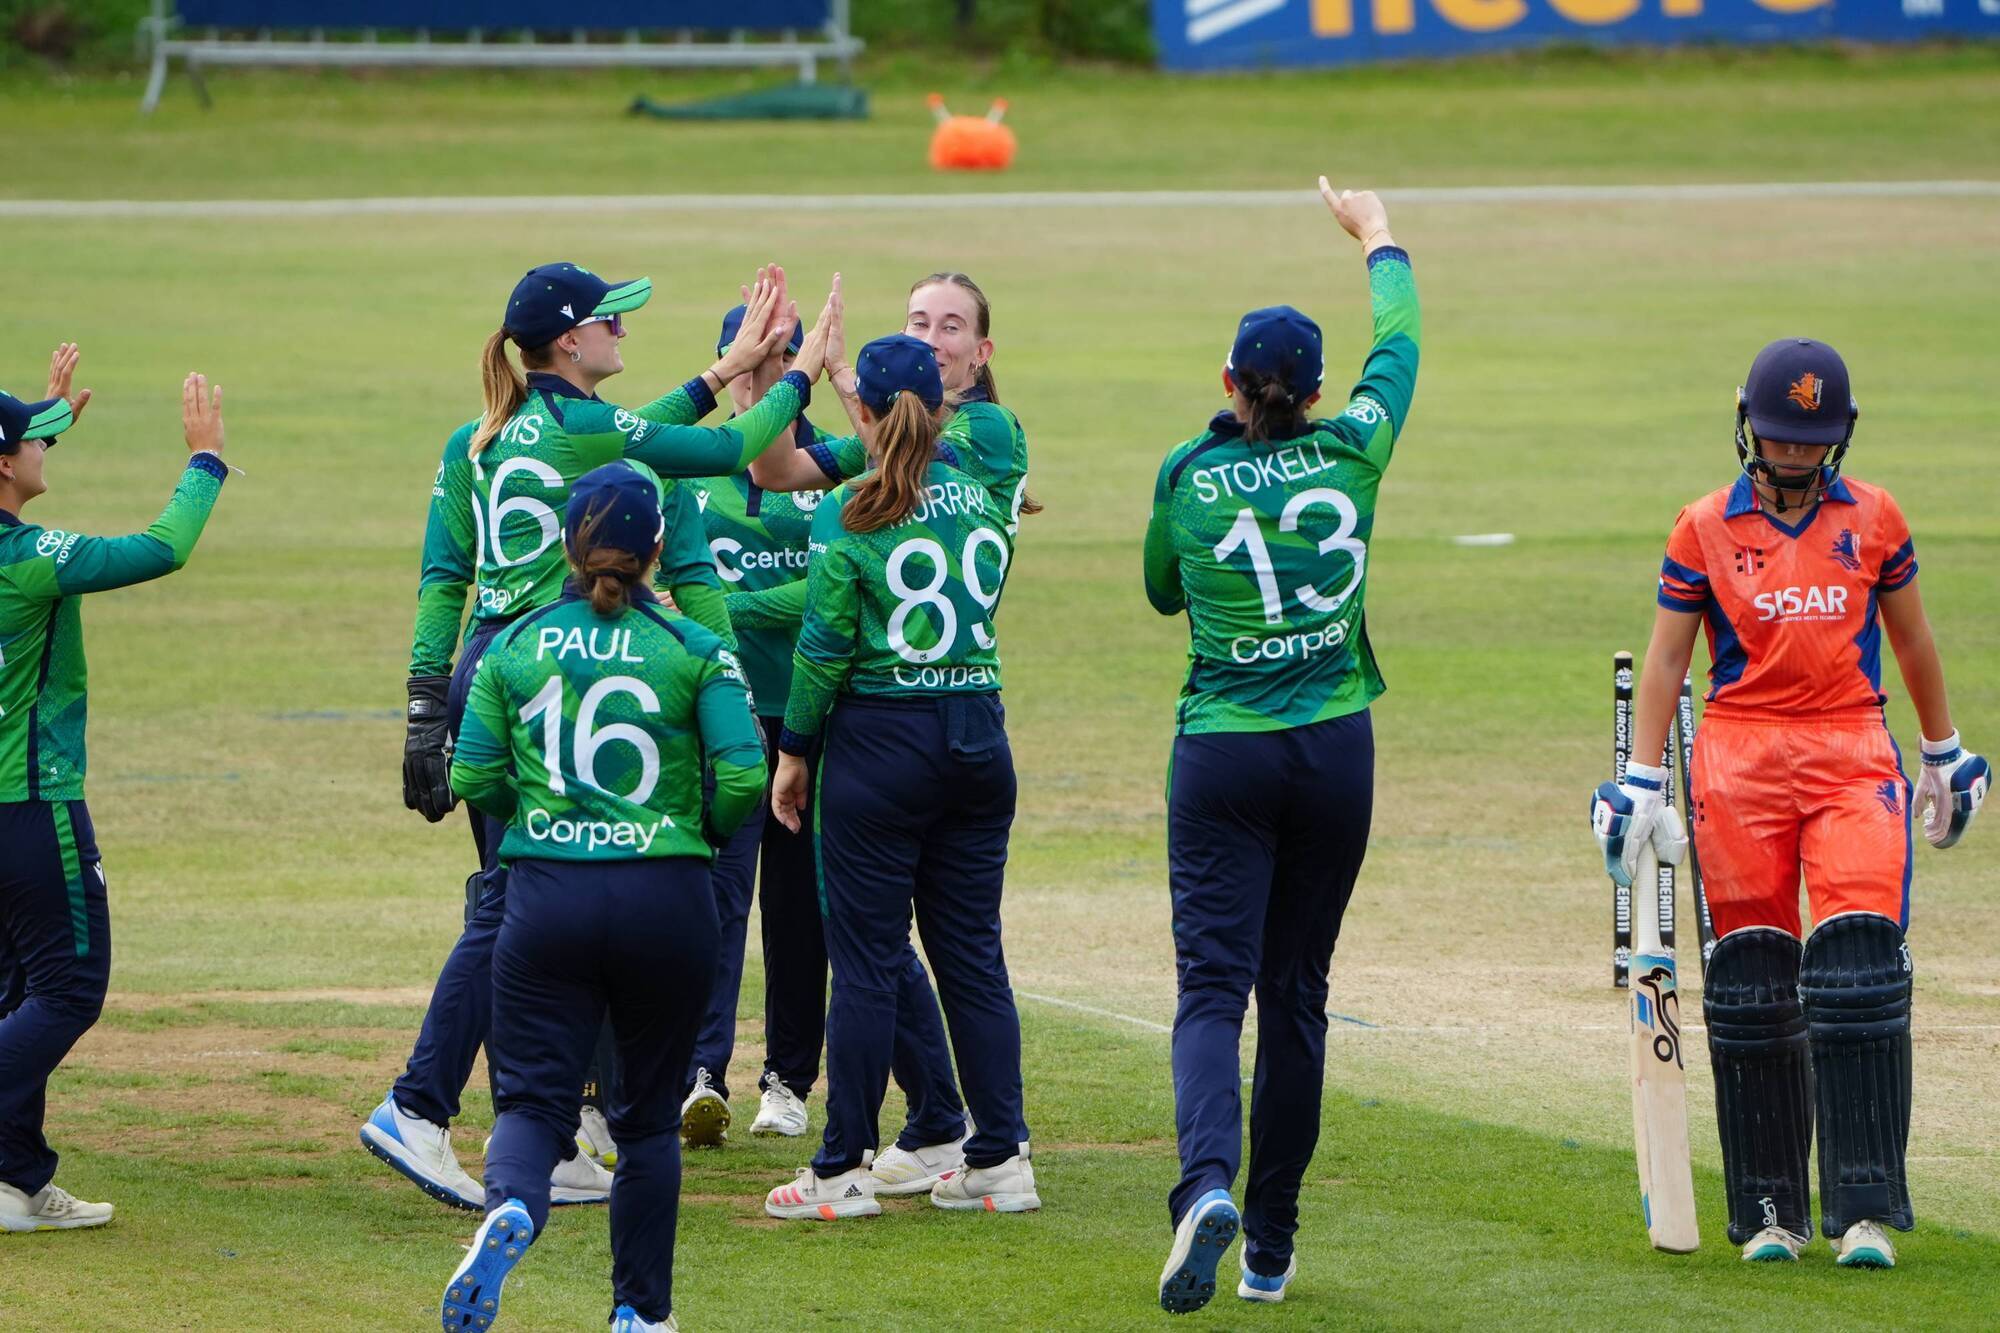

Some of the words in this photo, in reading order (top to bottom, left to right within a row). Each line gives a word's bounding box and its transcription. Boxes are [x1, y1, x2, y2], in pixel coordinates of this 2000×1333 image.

[1192, 441, 1337, 503] STOKELL
[892, 481, 988, 528] URRAY
[1213, 487, 1366, 624] 13
[886, 527, 1008, 663] 89
[1753, 585, 1848, 621] SISAR
[535, 627, 645, 663] PAUL
[518, 674, 662, 806] 16
[1615, 699, 1627, 749] EUROPE
[1679, 696, 1693, 745] EUROPE
[1616, 886, 1630, 932] EAM11
[1659, 867, 1673, 932] DREAM11
